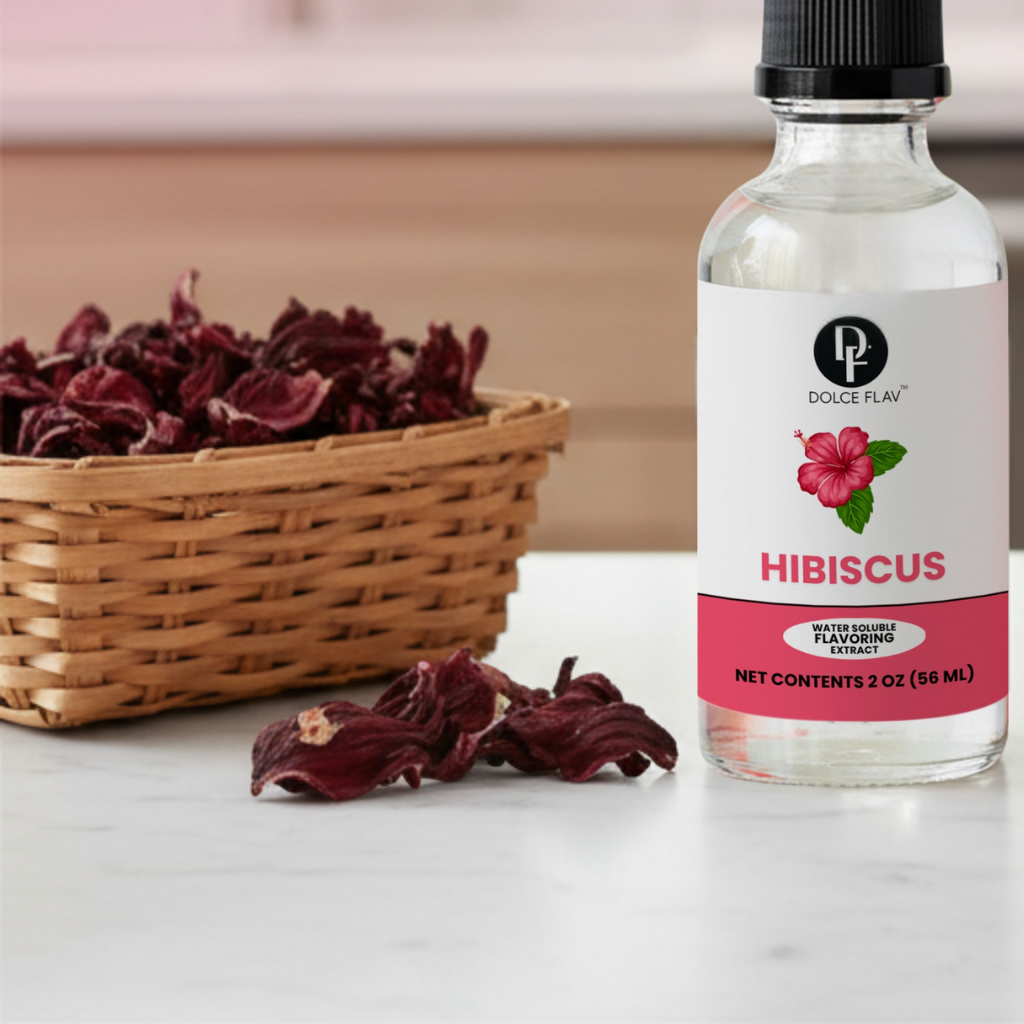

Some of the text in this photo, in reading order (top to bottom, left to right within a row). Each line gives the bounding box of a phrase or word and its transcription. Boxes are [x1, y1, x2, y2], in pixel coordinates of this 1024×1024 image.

[809, 391, 860, 404] DOLCE
[761, 551, 946, 585] HIBISCUS
[812, 622, 897, 633] WATER SOLUBLE
[814, 632, 895, 645] FLAVORING
[830, 645, 879, 655] EXTRACT
[735, 663, 974, 690] NET CONTENTS 2 OZ (56 ML)
